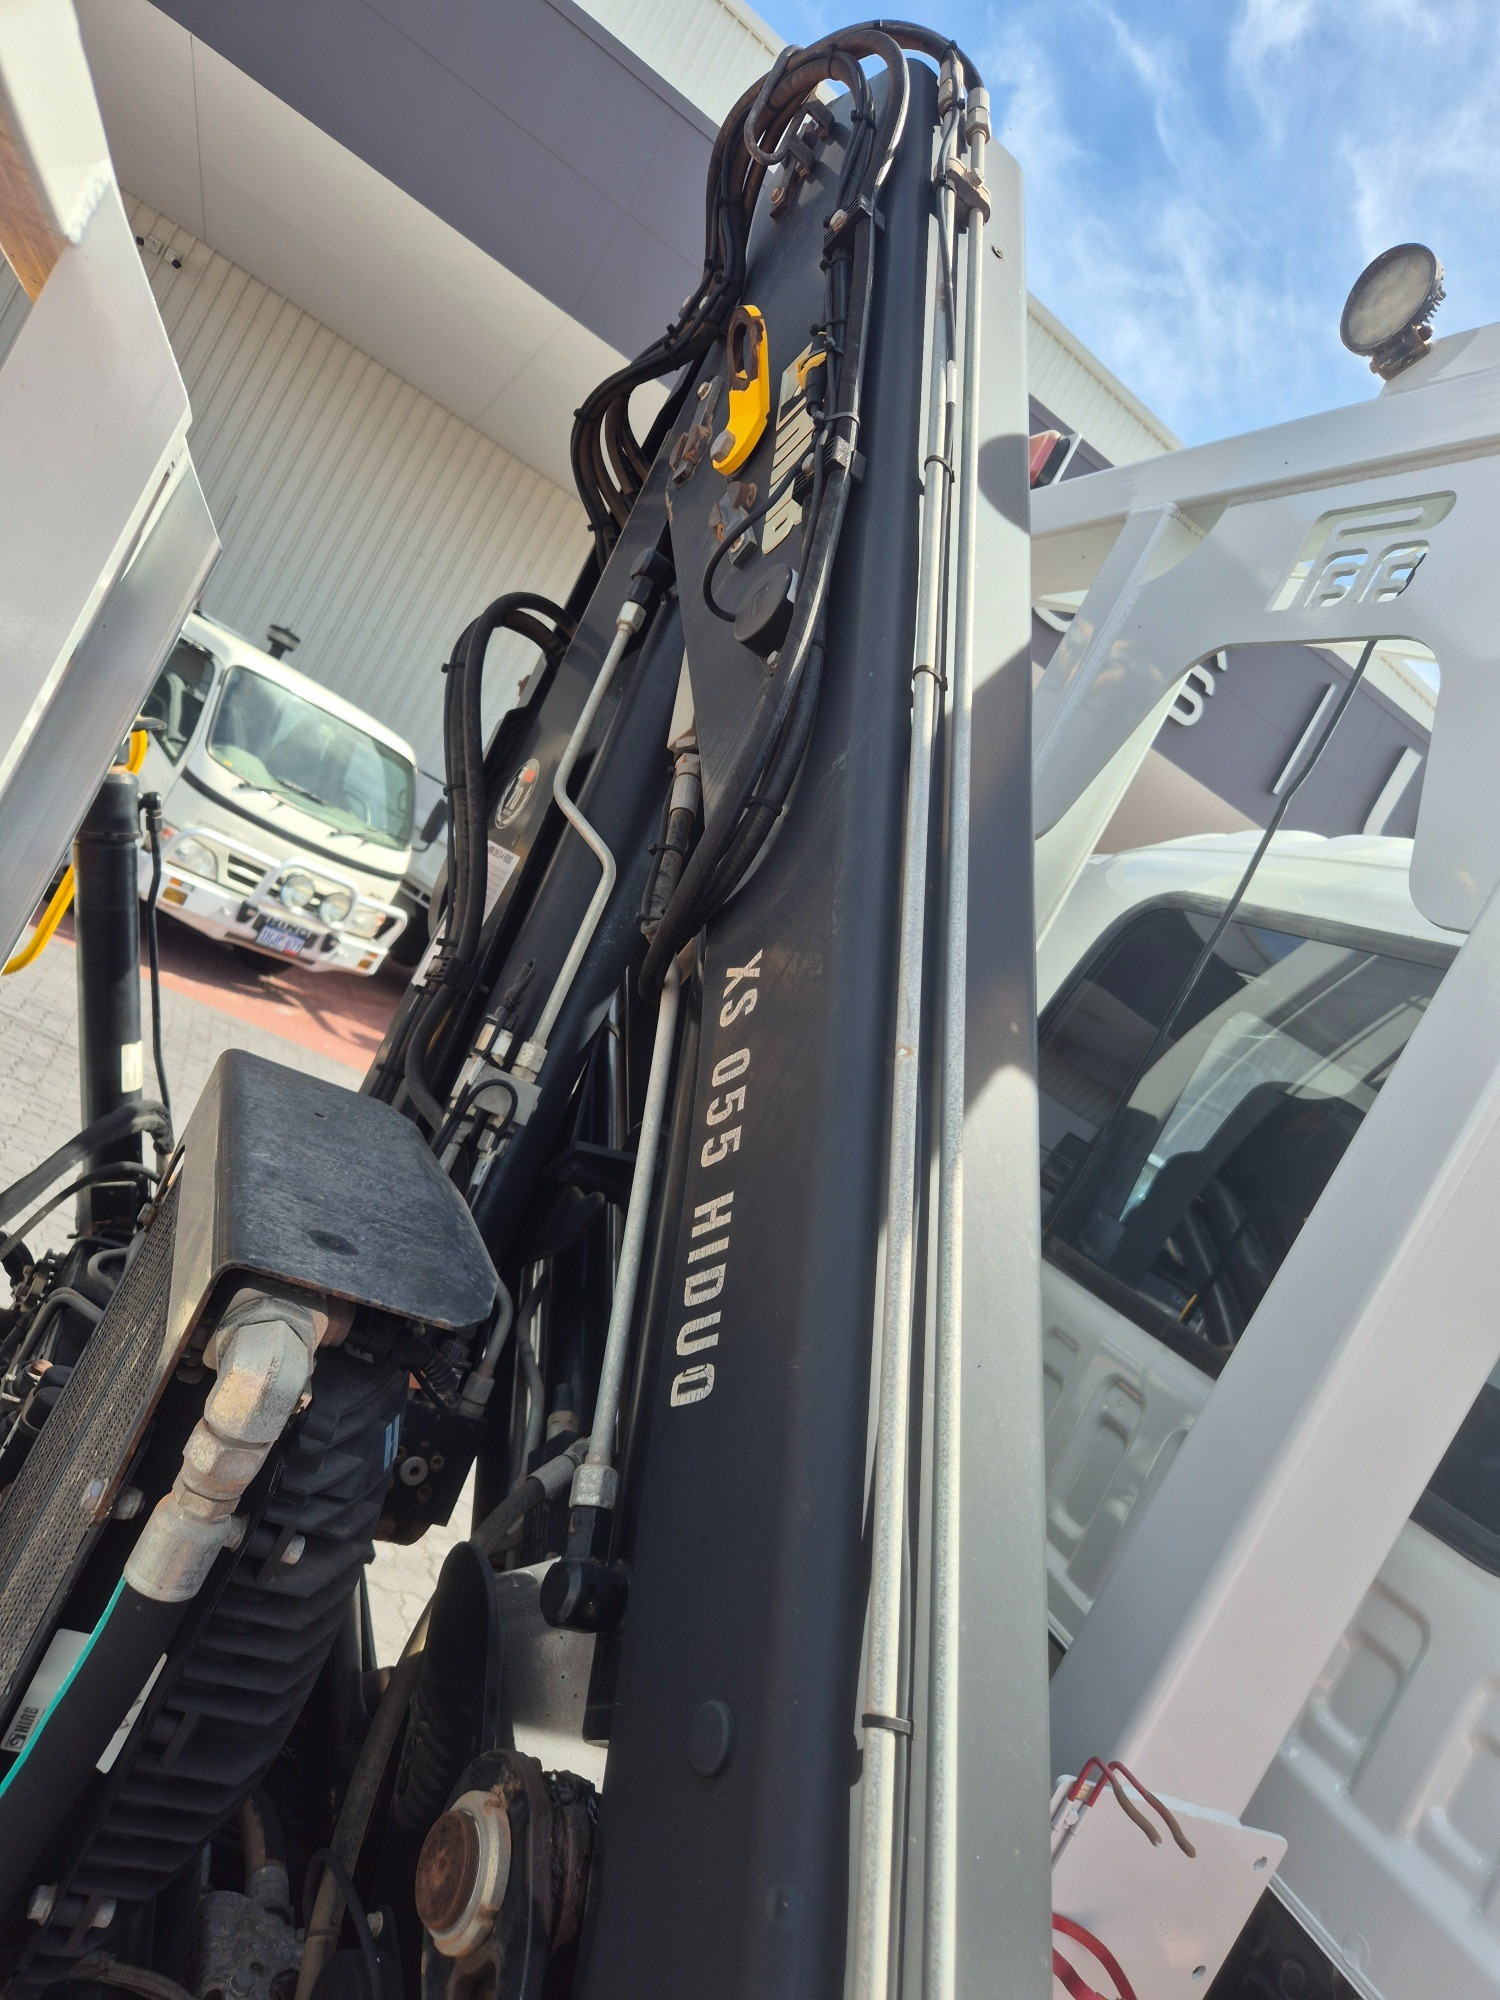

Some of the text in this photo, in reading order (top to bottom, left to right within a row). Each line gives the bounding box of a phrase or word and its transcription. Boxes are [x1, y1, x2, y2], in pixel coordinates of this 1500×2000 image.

[670, 948, 763, 1407] XS 055 HIDUO
[14, 1706, 39, 1733] HIAB
